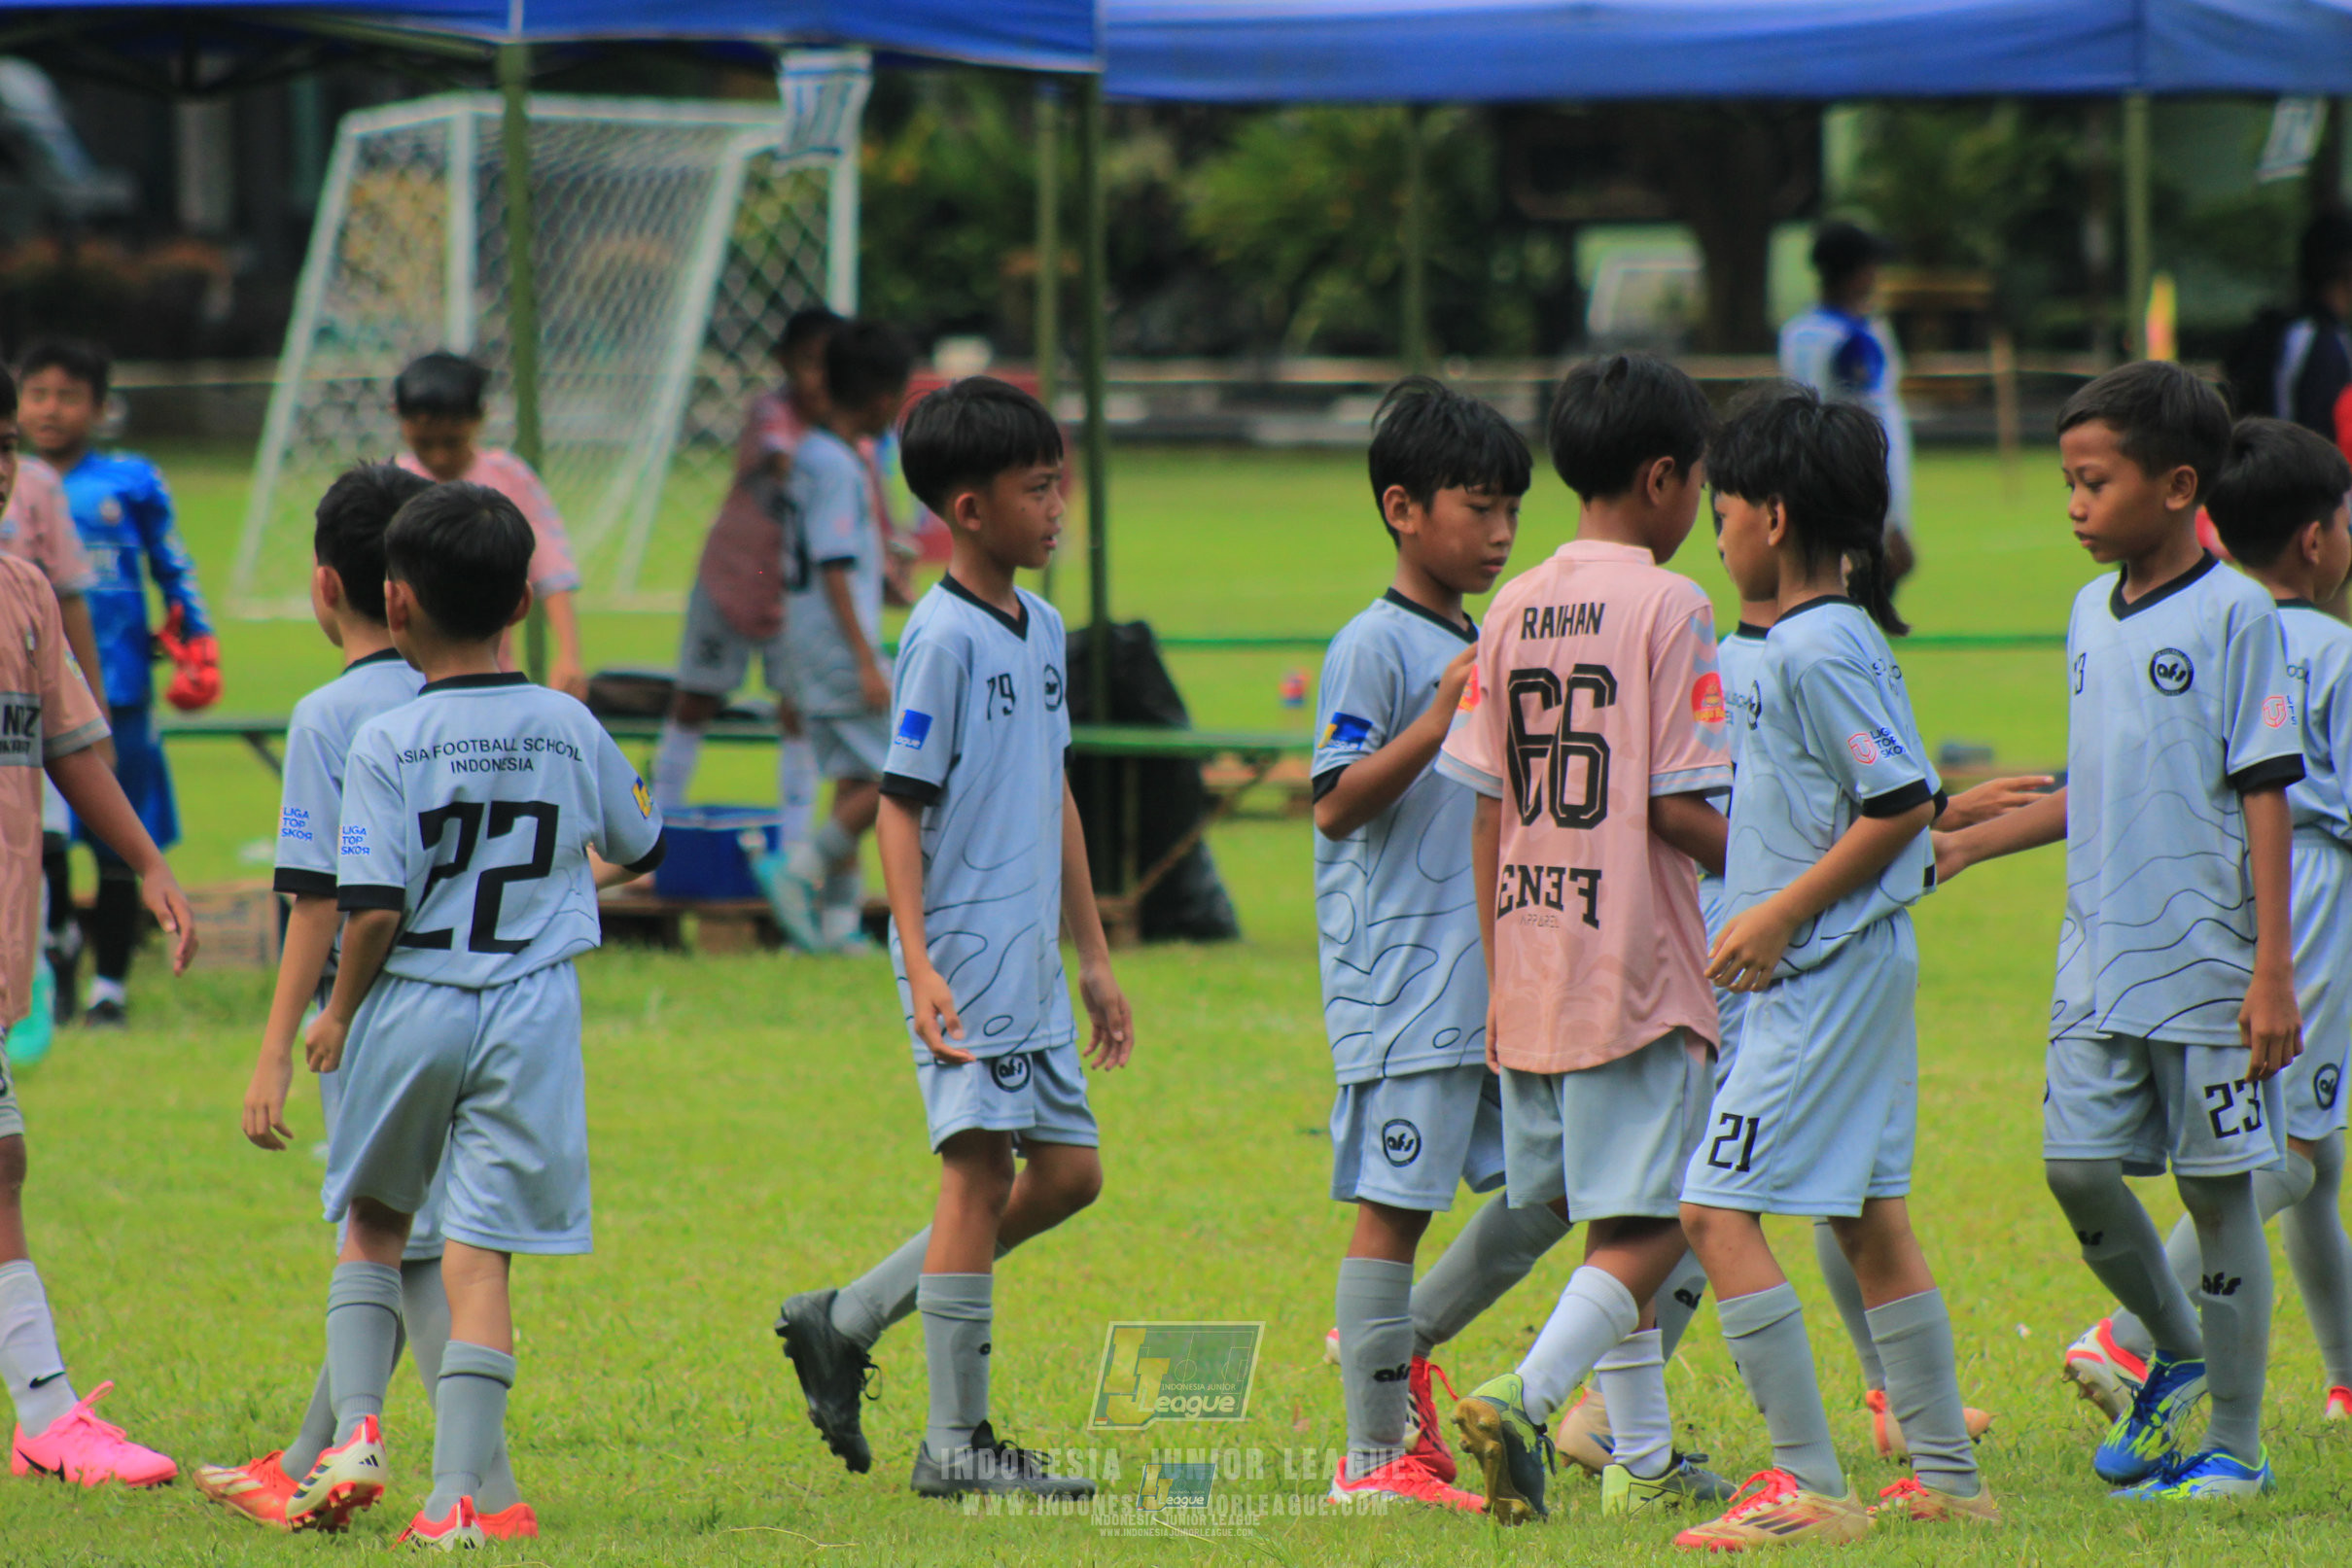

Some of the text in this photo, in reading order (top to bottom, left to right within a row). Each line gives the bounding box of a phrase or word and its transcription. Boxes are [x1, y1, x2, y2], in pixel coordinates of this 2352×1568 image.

[1521, 603, 1606, 640] RAIHAN
[433, 738, 519, 759] FOOTBALL
[523, 738, 583, 762] SCHOOL
[1505, 663, 1618, 830] 66
[450, 757, 535, 774] INDONESIA
[282, 817, 306, 828] TOP
[283, 806, 310, 819] LIGA
[341, 836, 364, 845] TOP
[342, 825, 367, 836] LIGA
[399, 800, 560, 955] 22
[2204, 1077, 2263, 1139] 23
[1707, 1112, 1761, 1172] 21
